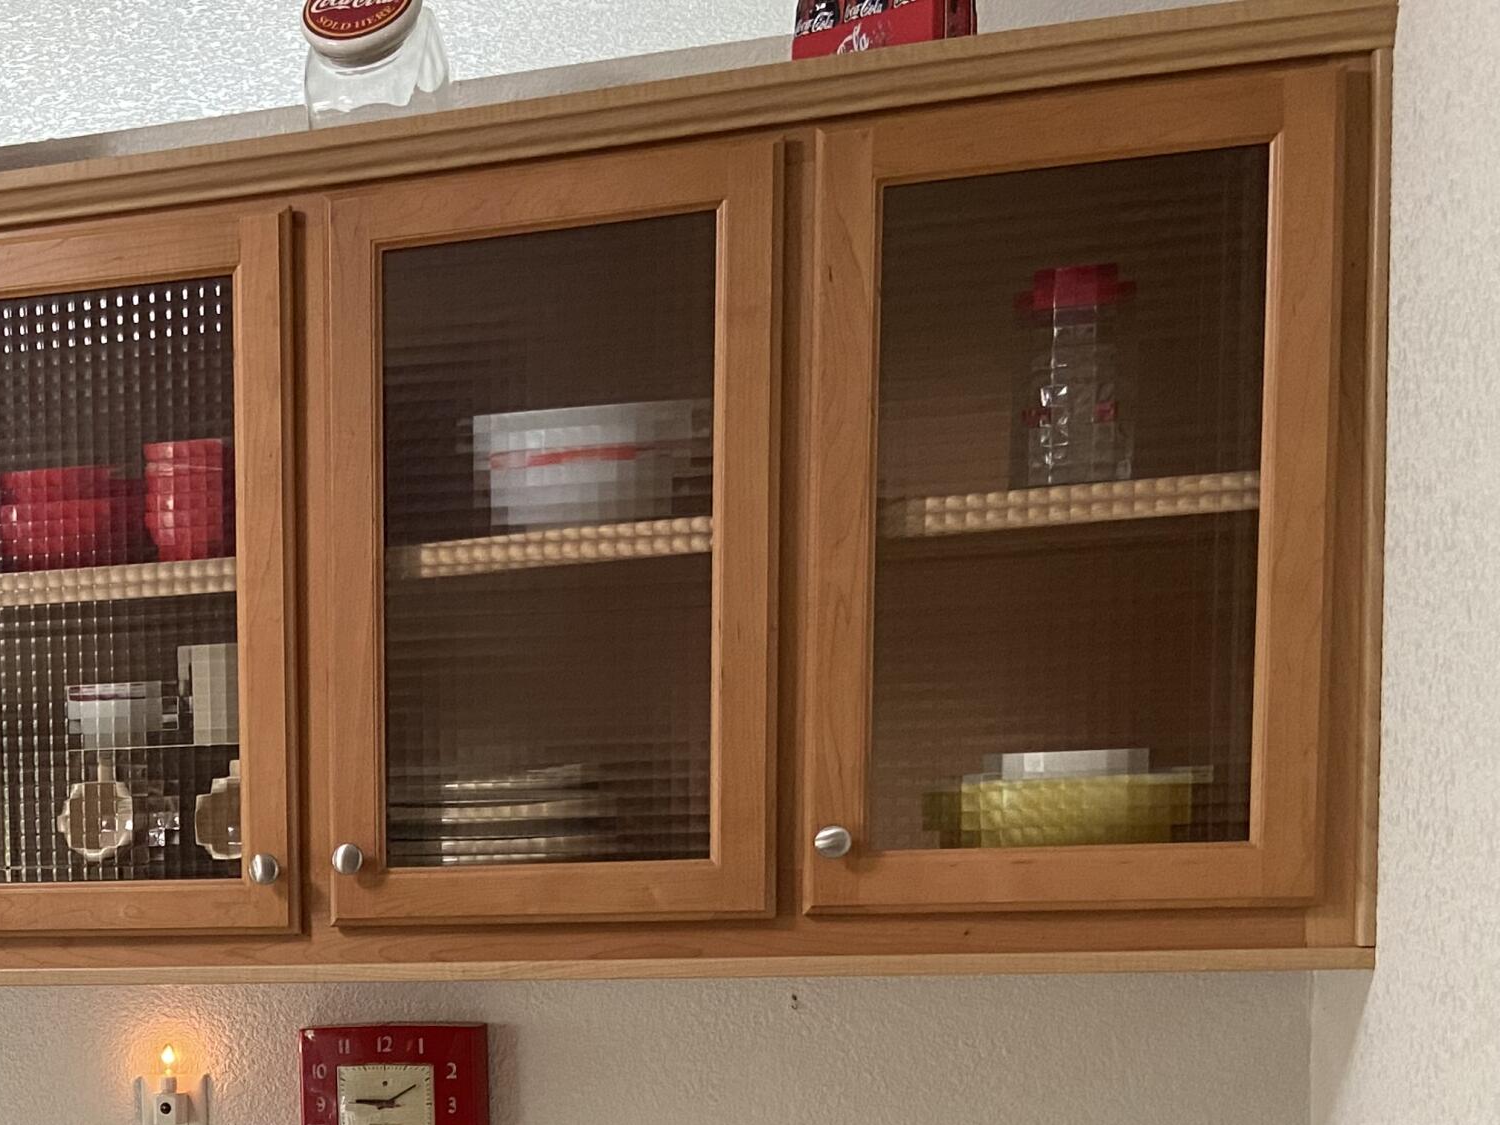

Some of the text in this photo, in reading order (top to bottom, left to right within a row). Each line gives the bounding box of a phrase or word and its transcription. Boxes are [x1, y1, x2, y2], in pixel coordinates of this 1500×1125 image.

[317, 5, 396, 31] SOLD HERE
[339, 1039, 350, 1054] 11
[377, 1036, 392, 1052] 12
[418, 1038, 424, 1054] 1
[312, 1064, 327, 1079] 10
[446, 1062, 457, 1079] 2
[316, 1097, 326, 1112] 9
[448, 1097, 456, 1114] 3
